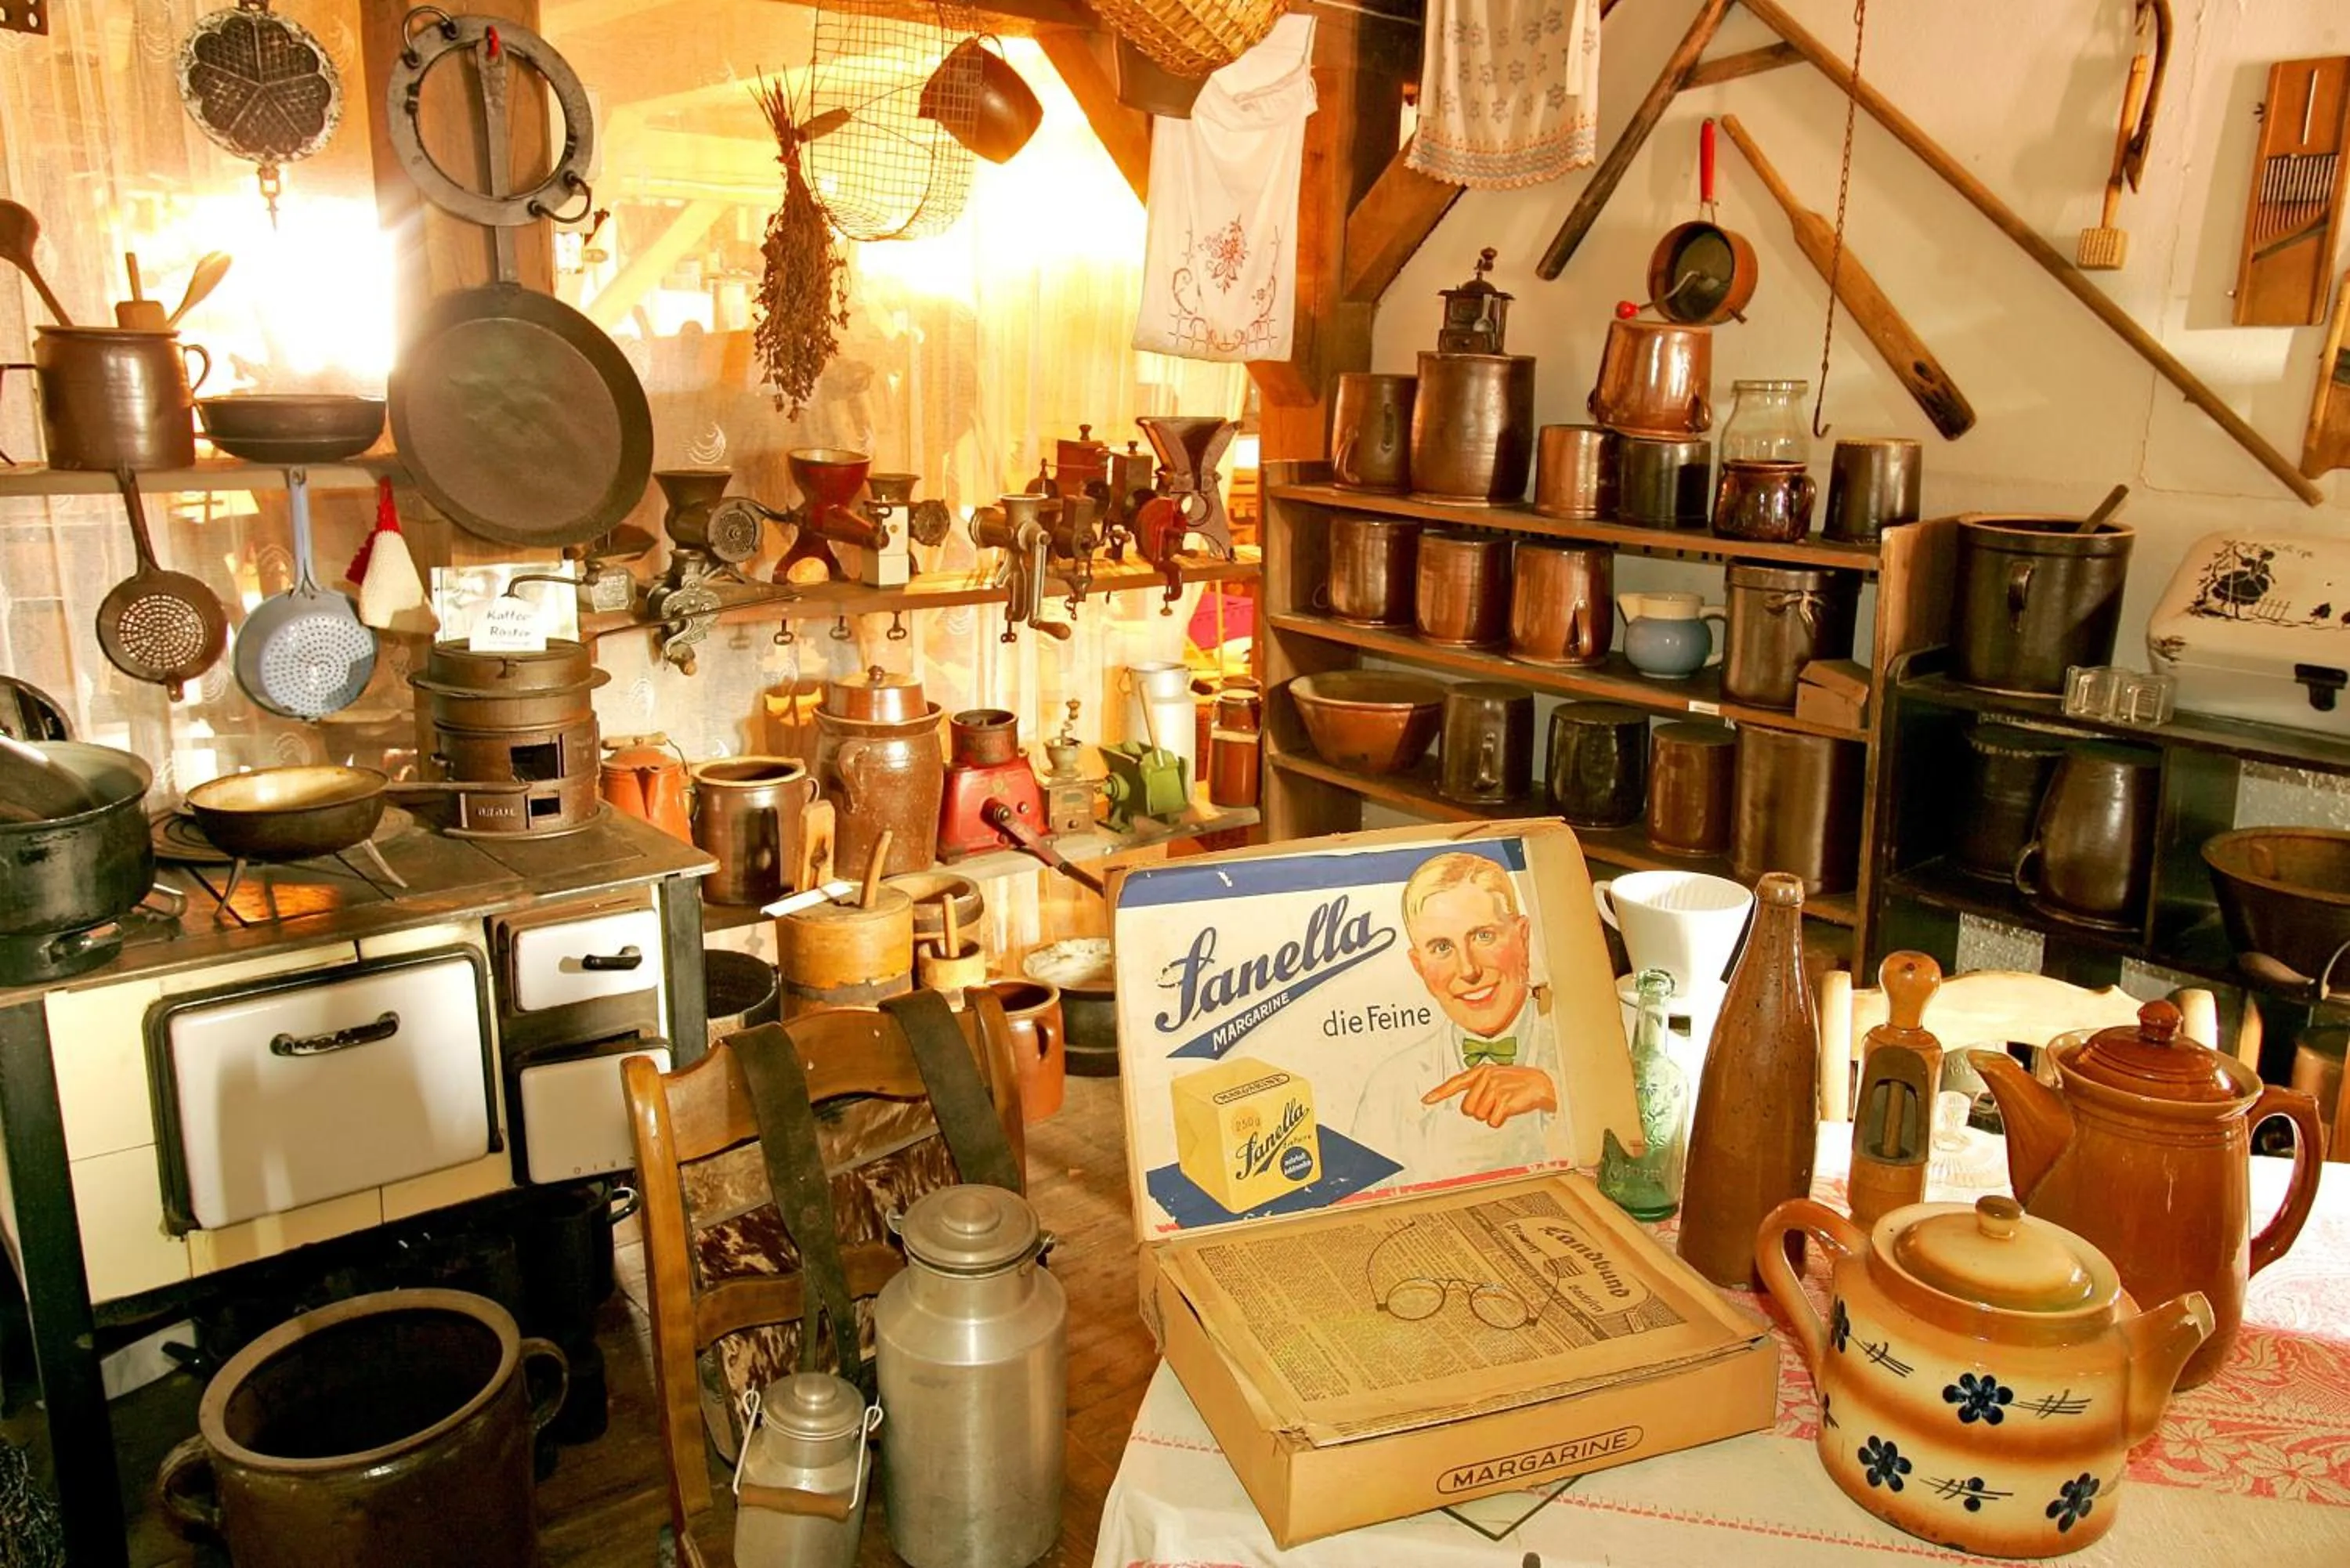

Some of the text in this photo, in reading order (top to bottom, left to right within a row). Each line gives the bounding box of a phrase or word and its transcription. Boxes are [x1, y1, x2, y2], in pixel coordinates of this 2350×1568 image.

[1155, 894, 1396, 1033] Sanella
[1213, 992, 1290, 1052] MARGARINE
[1323, 1003, 1431, 1036] die Feine
[1235, 1097, 1310, 1180] Sanella
[1538, 1226, 1630, 1298] Landbund
[1453, 1432, 1628, 1488] MARGARINE
